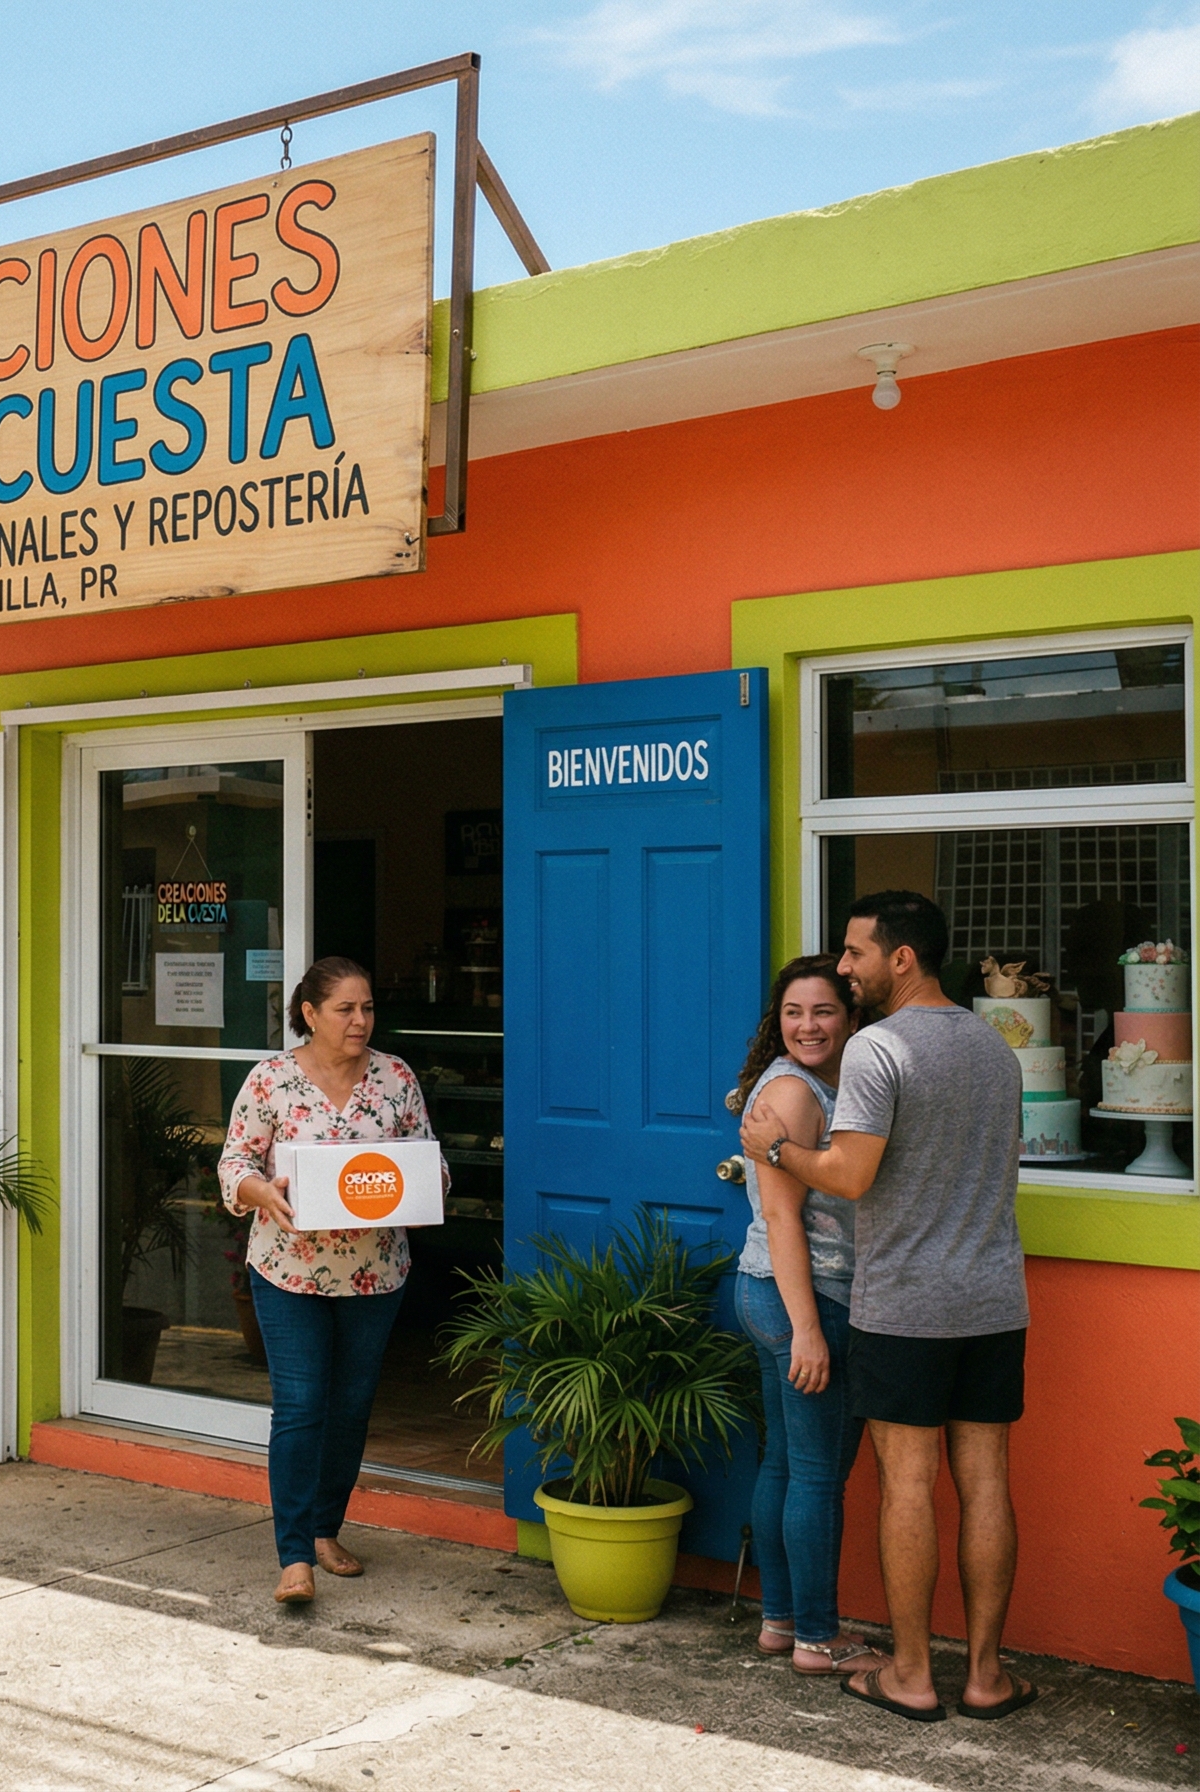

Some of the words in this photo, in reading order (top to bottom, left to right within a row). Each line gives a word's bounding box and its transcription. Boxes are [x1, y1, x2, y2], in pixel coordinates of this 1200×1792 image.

[113, 500, 135, 551] Y
[148, 451, 371, 547] REPOSTERÍA
[79, 562, 119, 603] PR
[548, 739, 709, 788] BIENVENIDOS
[157, 882, 227, 904] CREACIONES
[157, 903, 172, 924] DE
[173, 903, 187, 923] LA
[344, 1182, 398, 1195] CUESTA
